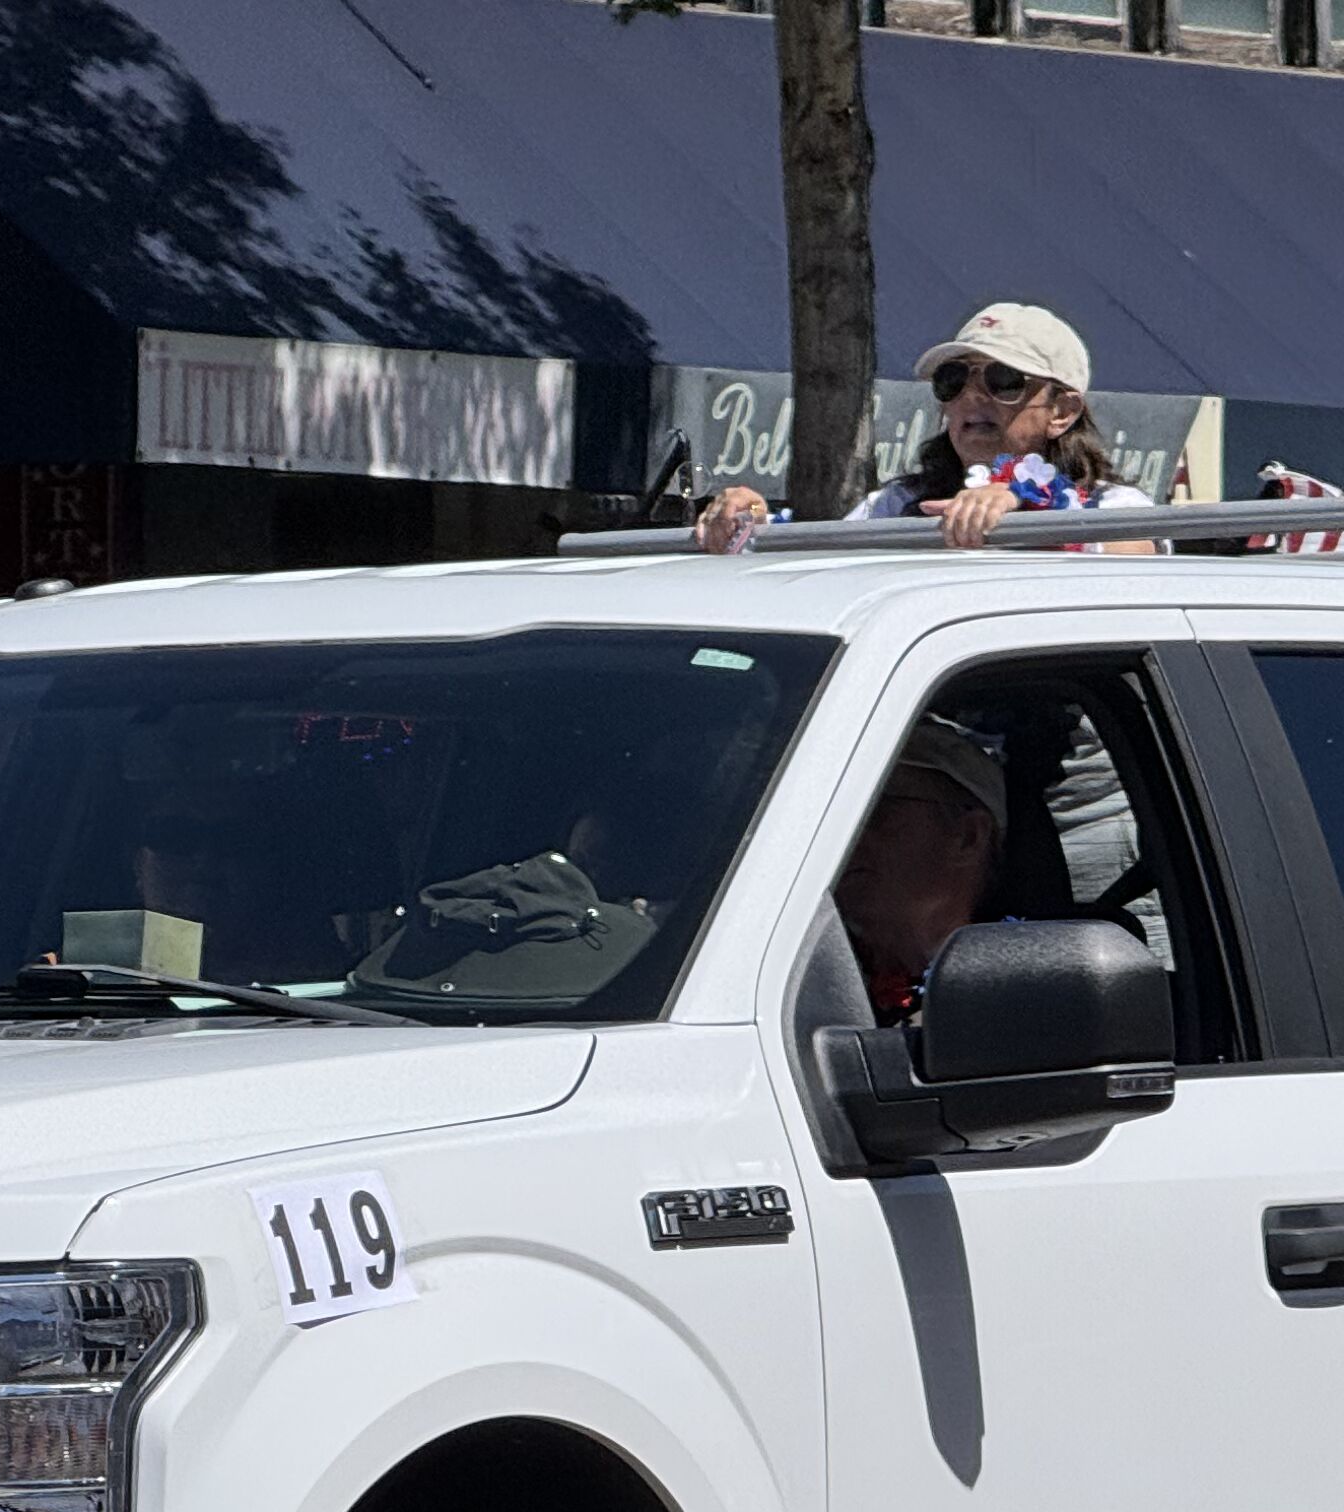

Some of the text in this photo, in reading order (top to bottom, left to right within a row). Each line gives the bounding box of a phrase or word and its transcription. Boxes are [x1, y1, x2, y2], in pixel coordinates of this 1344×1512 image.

[711, 382, 1169, 500] Bel ail ing
[269, 1189, 396, 1306] 119
